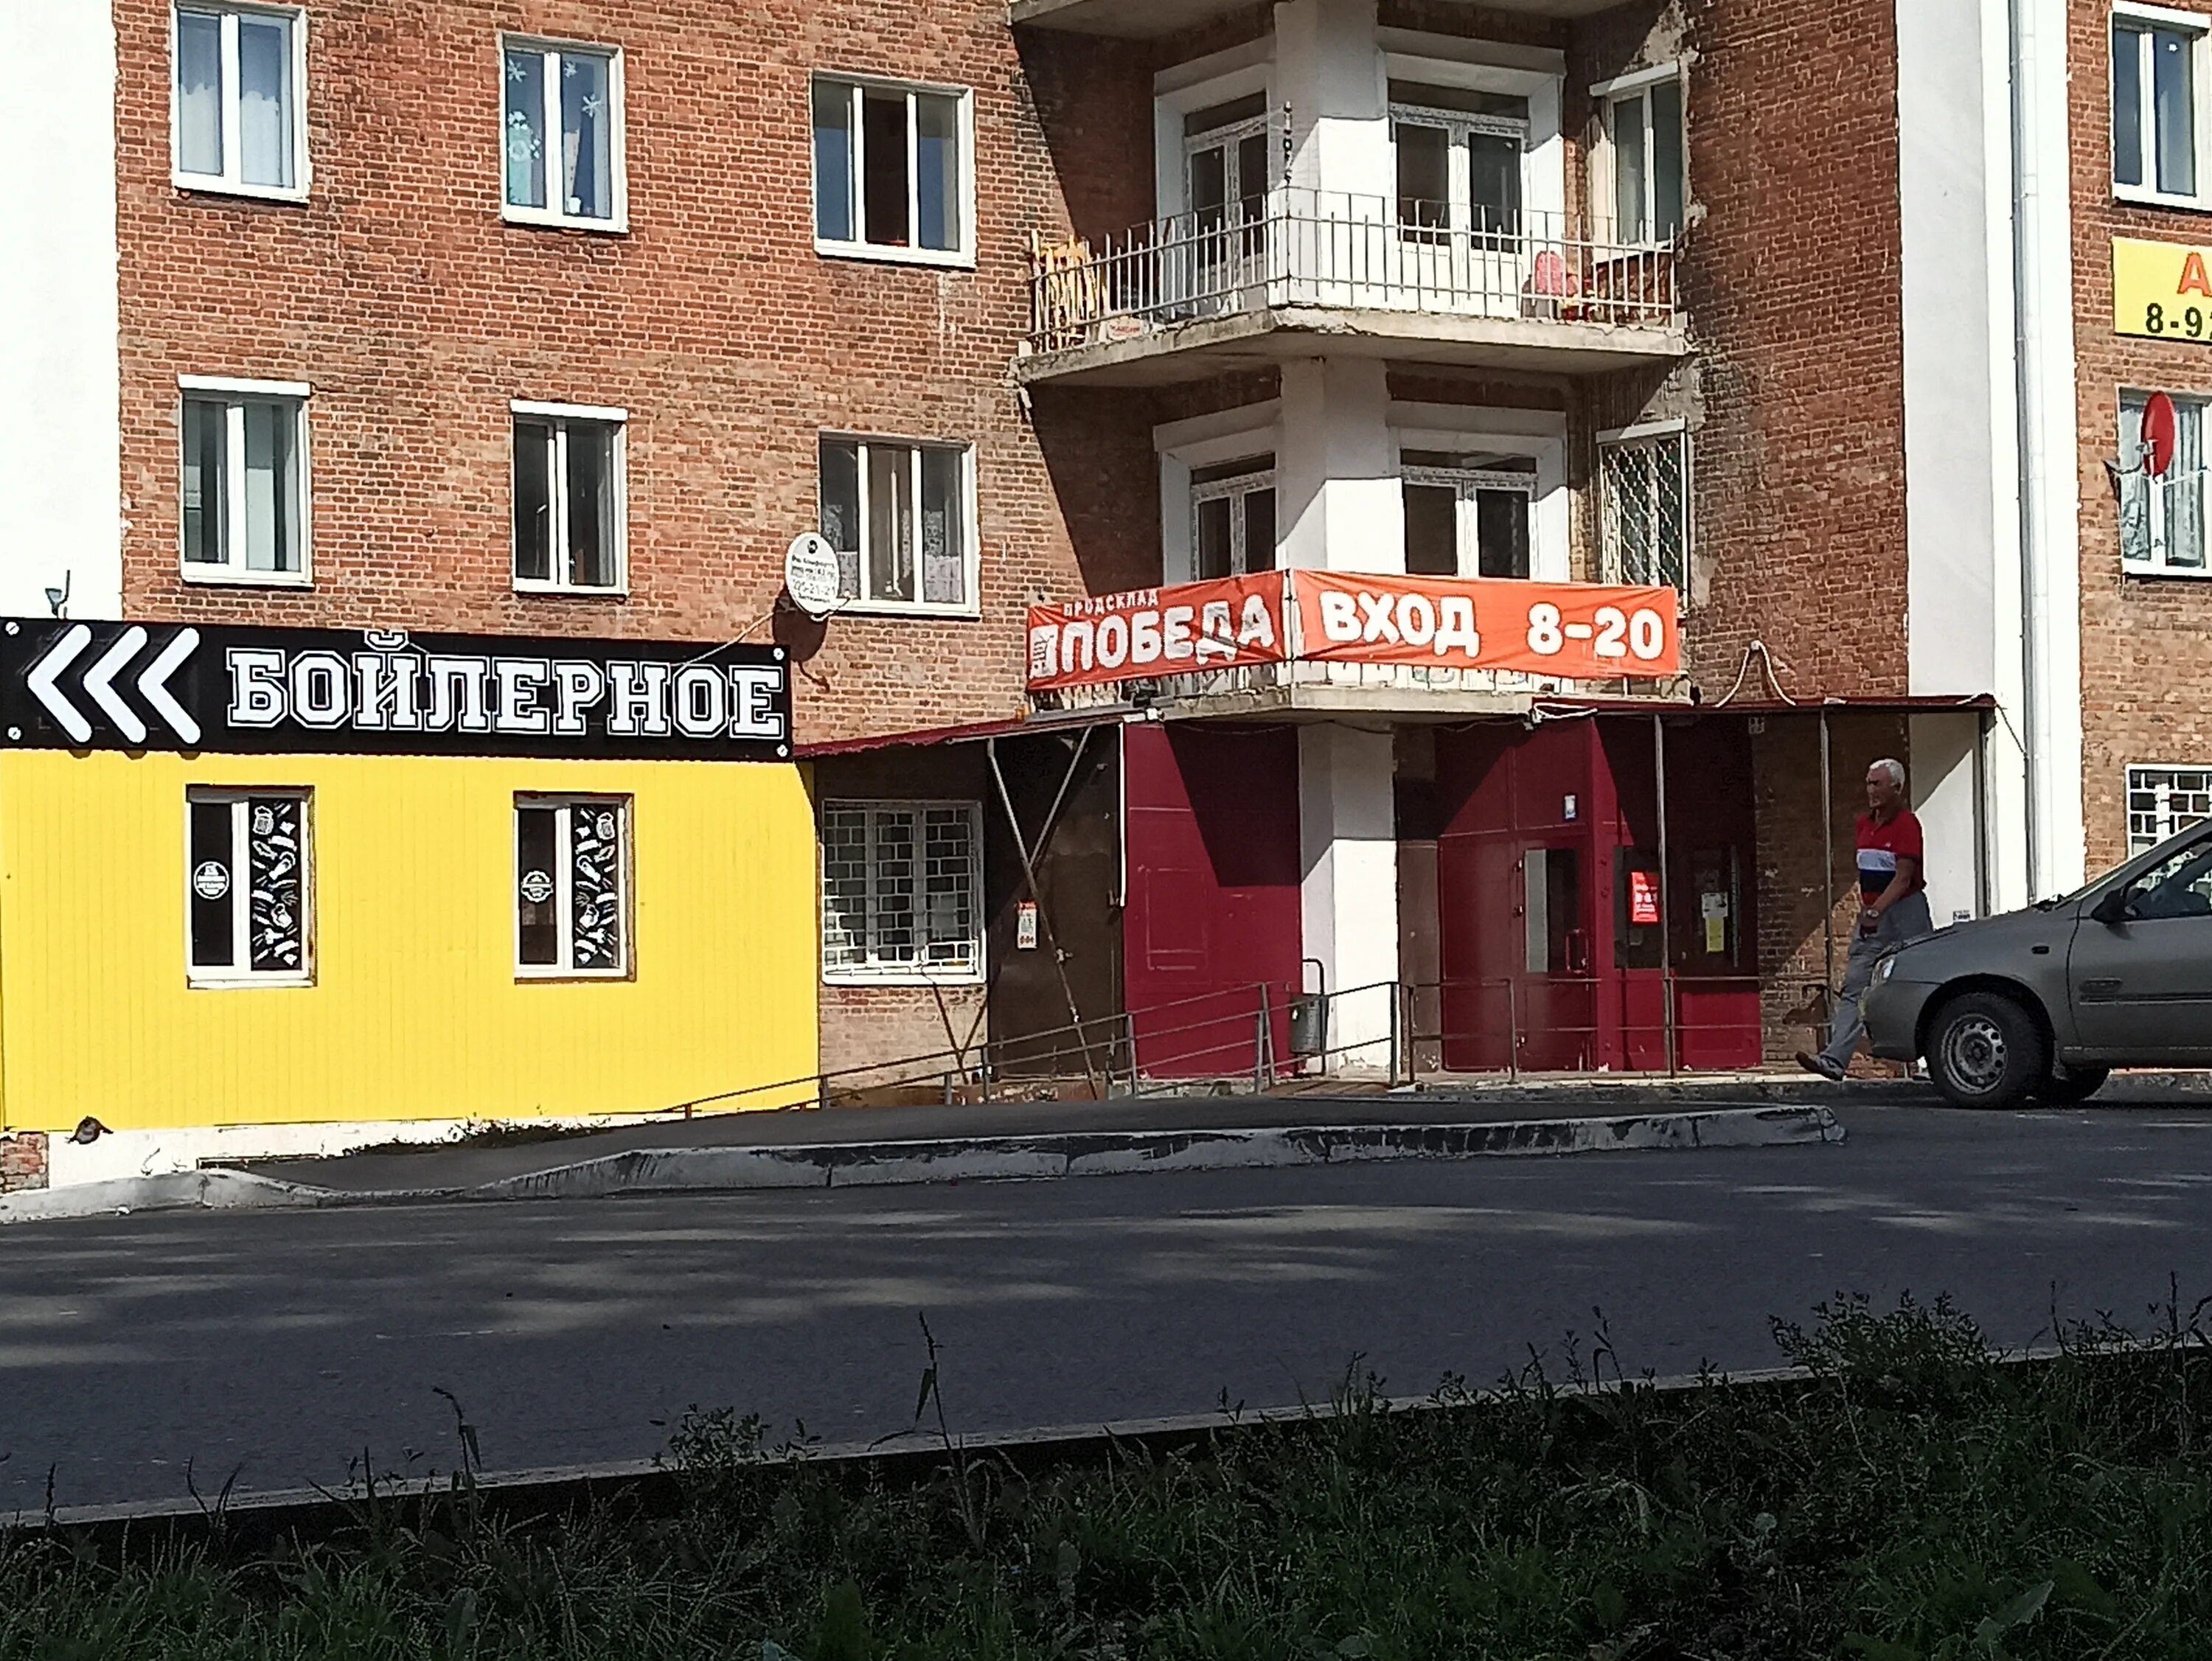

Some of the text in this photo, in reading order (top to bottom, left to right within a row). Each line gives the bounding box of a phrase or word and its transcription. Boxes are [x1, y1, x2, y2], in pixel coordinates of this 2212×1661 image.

[2146, 303, 2212, 340] 8-9
[1061, 594, 1275, 673] ПОБЕДА
[1064, 588, 1158, 616] ПРОДСКЛАД
[1319, 590, 1665, 661] ВХОД 8-20
[226, 630, 784, 739] БОЙЛЕРНОЕ
